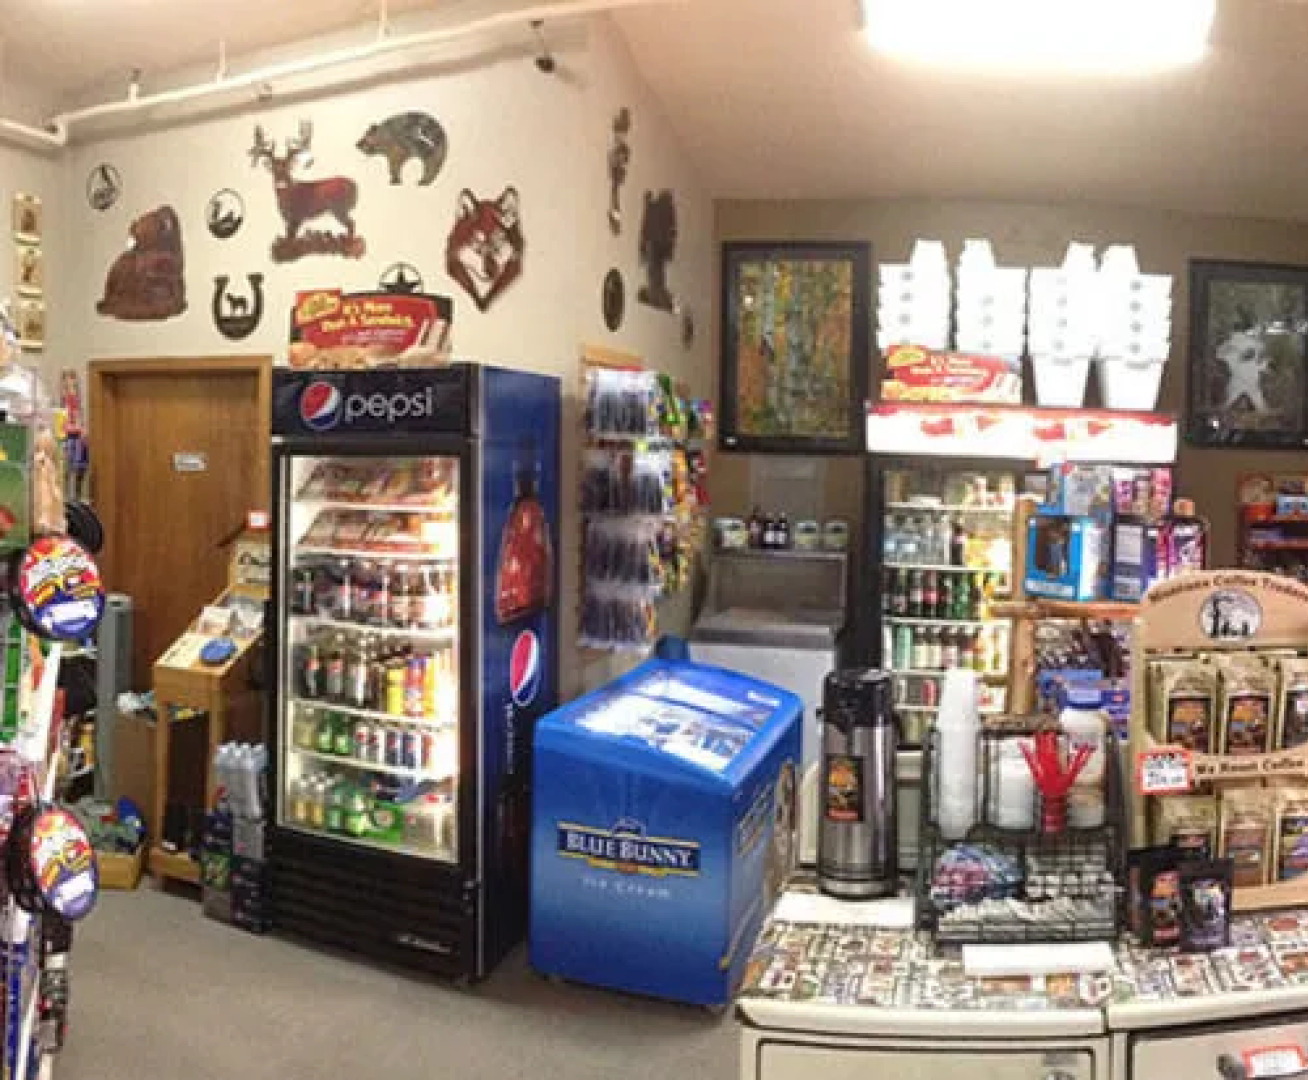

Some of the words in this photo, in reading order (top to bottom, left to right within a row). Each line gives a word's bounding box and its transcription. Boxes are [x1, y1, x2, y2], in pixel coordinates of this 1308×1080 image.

[344, 386, 433, 423] pepsi
[1261, 757, 1304, 773] Coffee
[566, 832, 616, 858] BLUE
[619, 841, 692, 867] BUNNY
